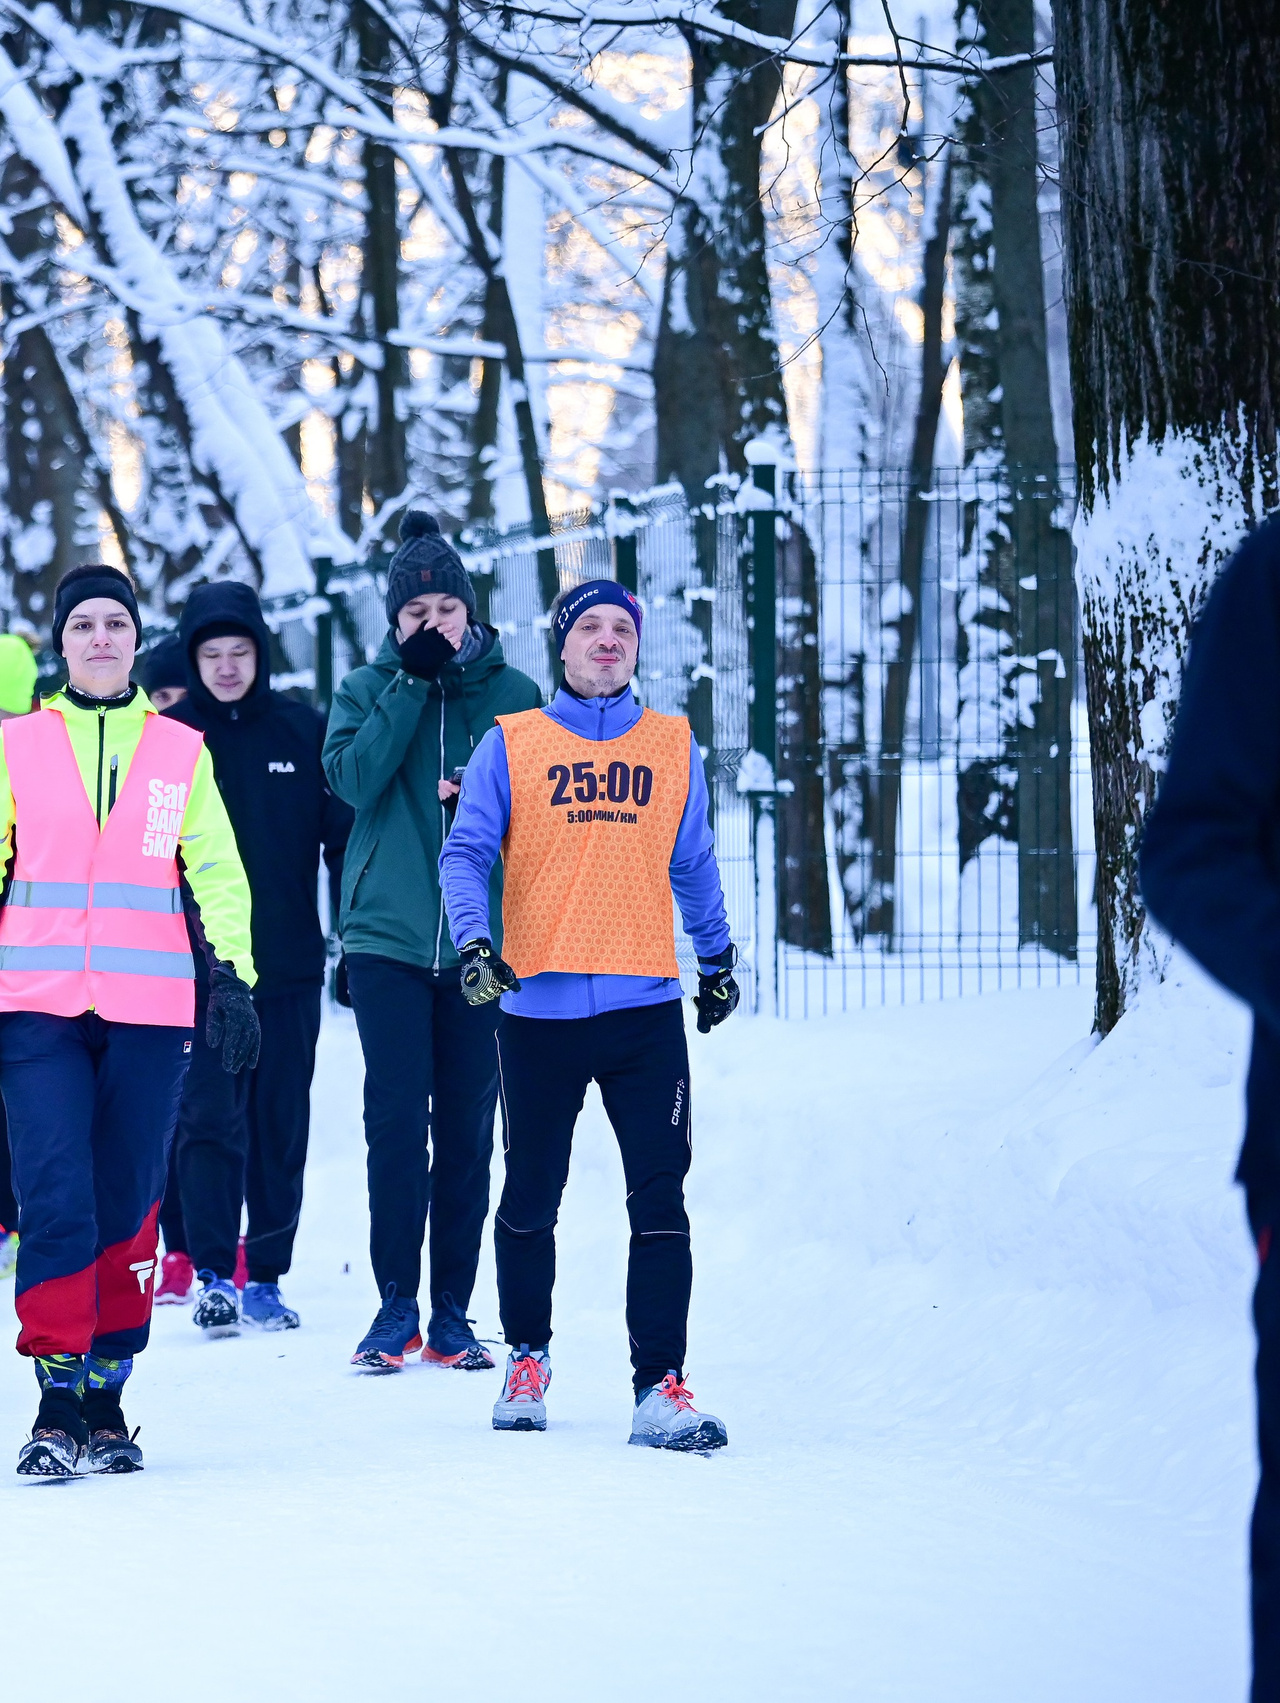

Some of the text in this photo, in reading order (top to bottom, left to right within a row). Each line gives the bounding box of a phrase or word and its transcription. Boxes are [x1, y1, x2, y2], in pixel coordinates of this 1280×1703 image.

[569, 589, 599, 612] Rostec
[268, 761, 296, 773] FILA
[148, 778, 187, 811] Sat
[548, 761, 653, 807] 25:00
[145, 807, 183, 835] 9AM
[141, 832, 179, 860] 5KM
[671, 1087, 684, 1126] CRAFT
